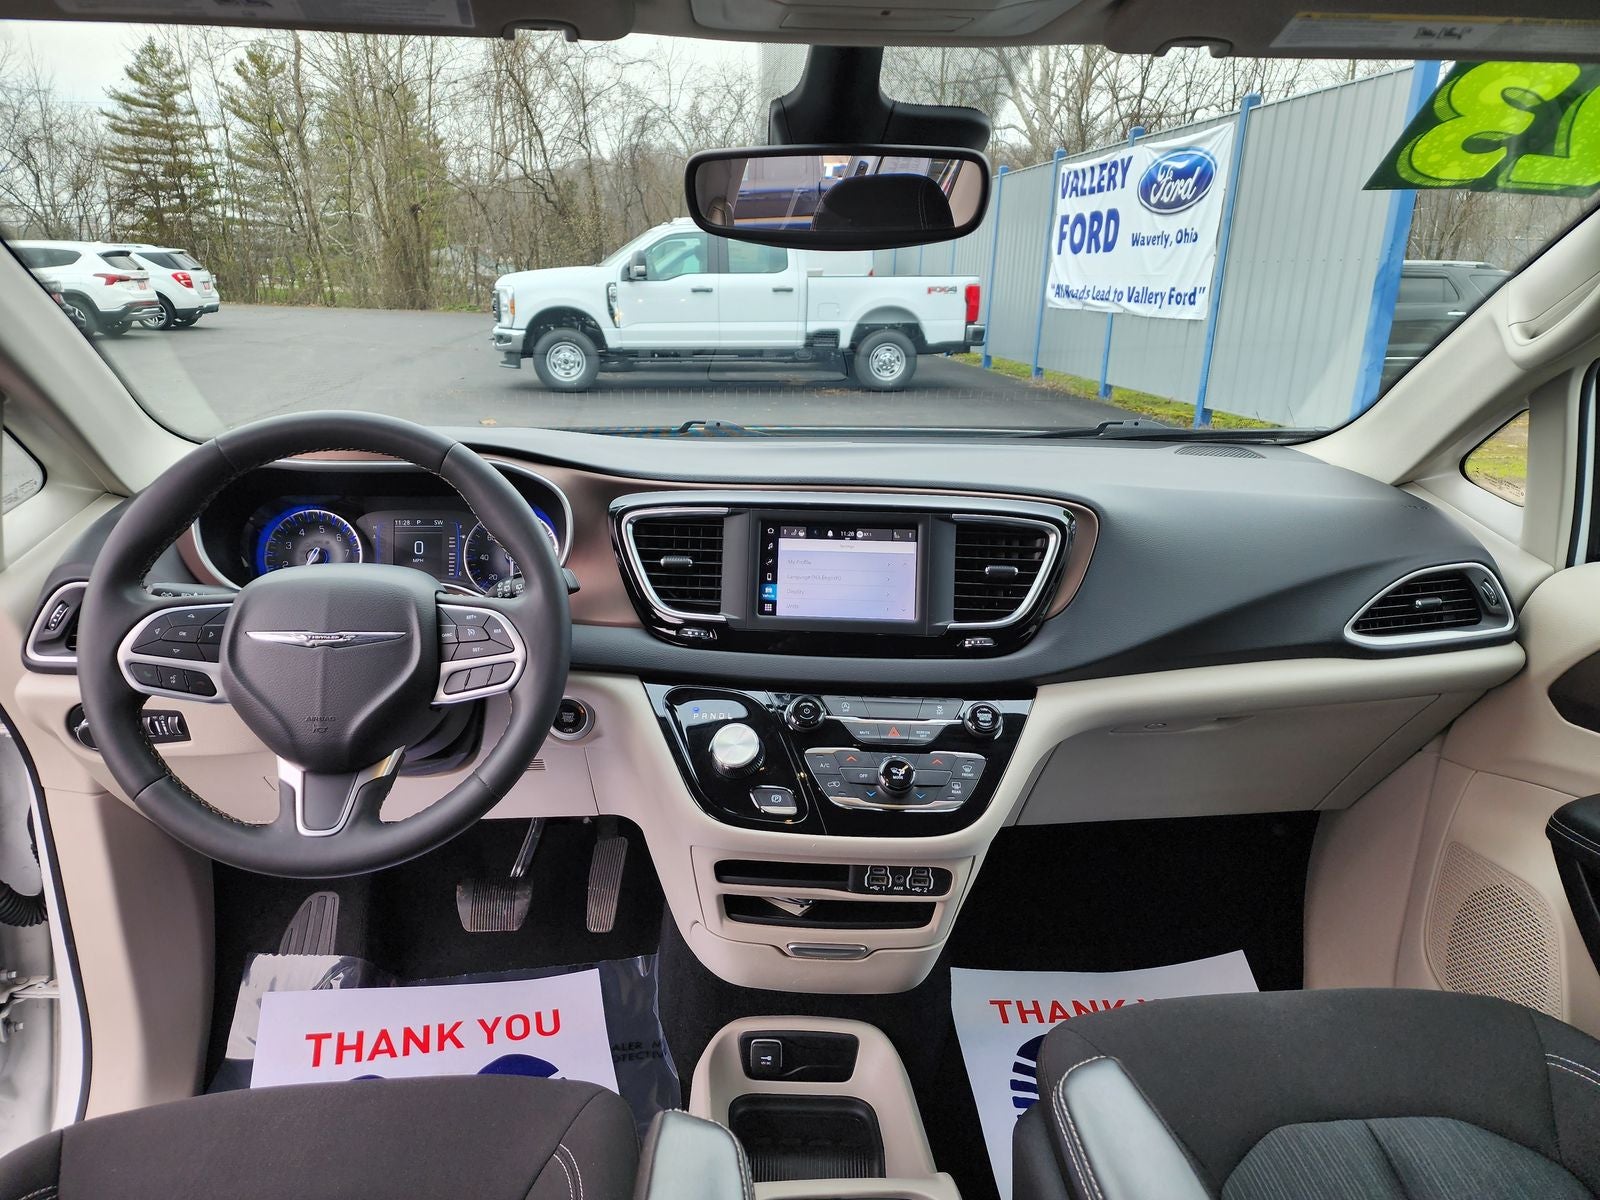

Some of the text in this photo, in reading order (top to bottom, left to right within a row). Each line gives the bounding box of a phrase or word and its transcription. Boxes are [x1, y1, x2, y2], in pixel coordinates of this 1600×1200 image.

[1060, 155, 1134, 200] VALLERY
[1151, 159, 1202, 204] Ford
[1057, 207, 1121, 256] FORD
[1131, 227, 1198, 249] Waverly, Ohio
[1091, 285, 1112, 301] Lead
[1112, 287, 1124, 302] to
[1127, 286, 1166, 309] Vallery
[298, 528, 305, 537] 4
[319, 525, 325, 534] 5
[336, 533, 342, 542] 6
[285, 541, 292, 550] 3
[414, 540, 424, 555] 0
[344, 548, 350, 558] 7
[480, 553, 489, 561] 40
[304, 1008, 562, 1068] THANK YOU
[612, 1041, 642, 1051] ALER
